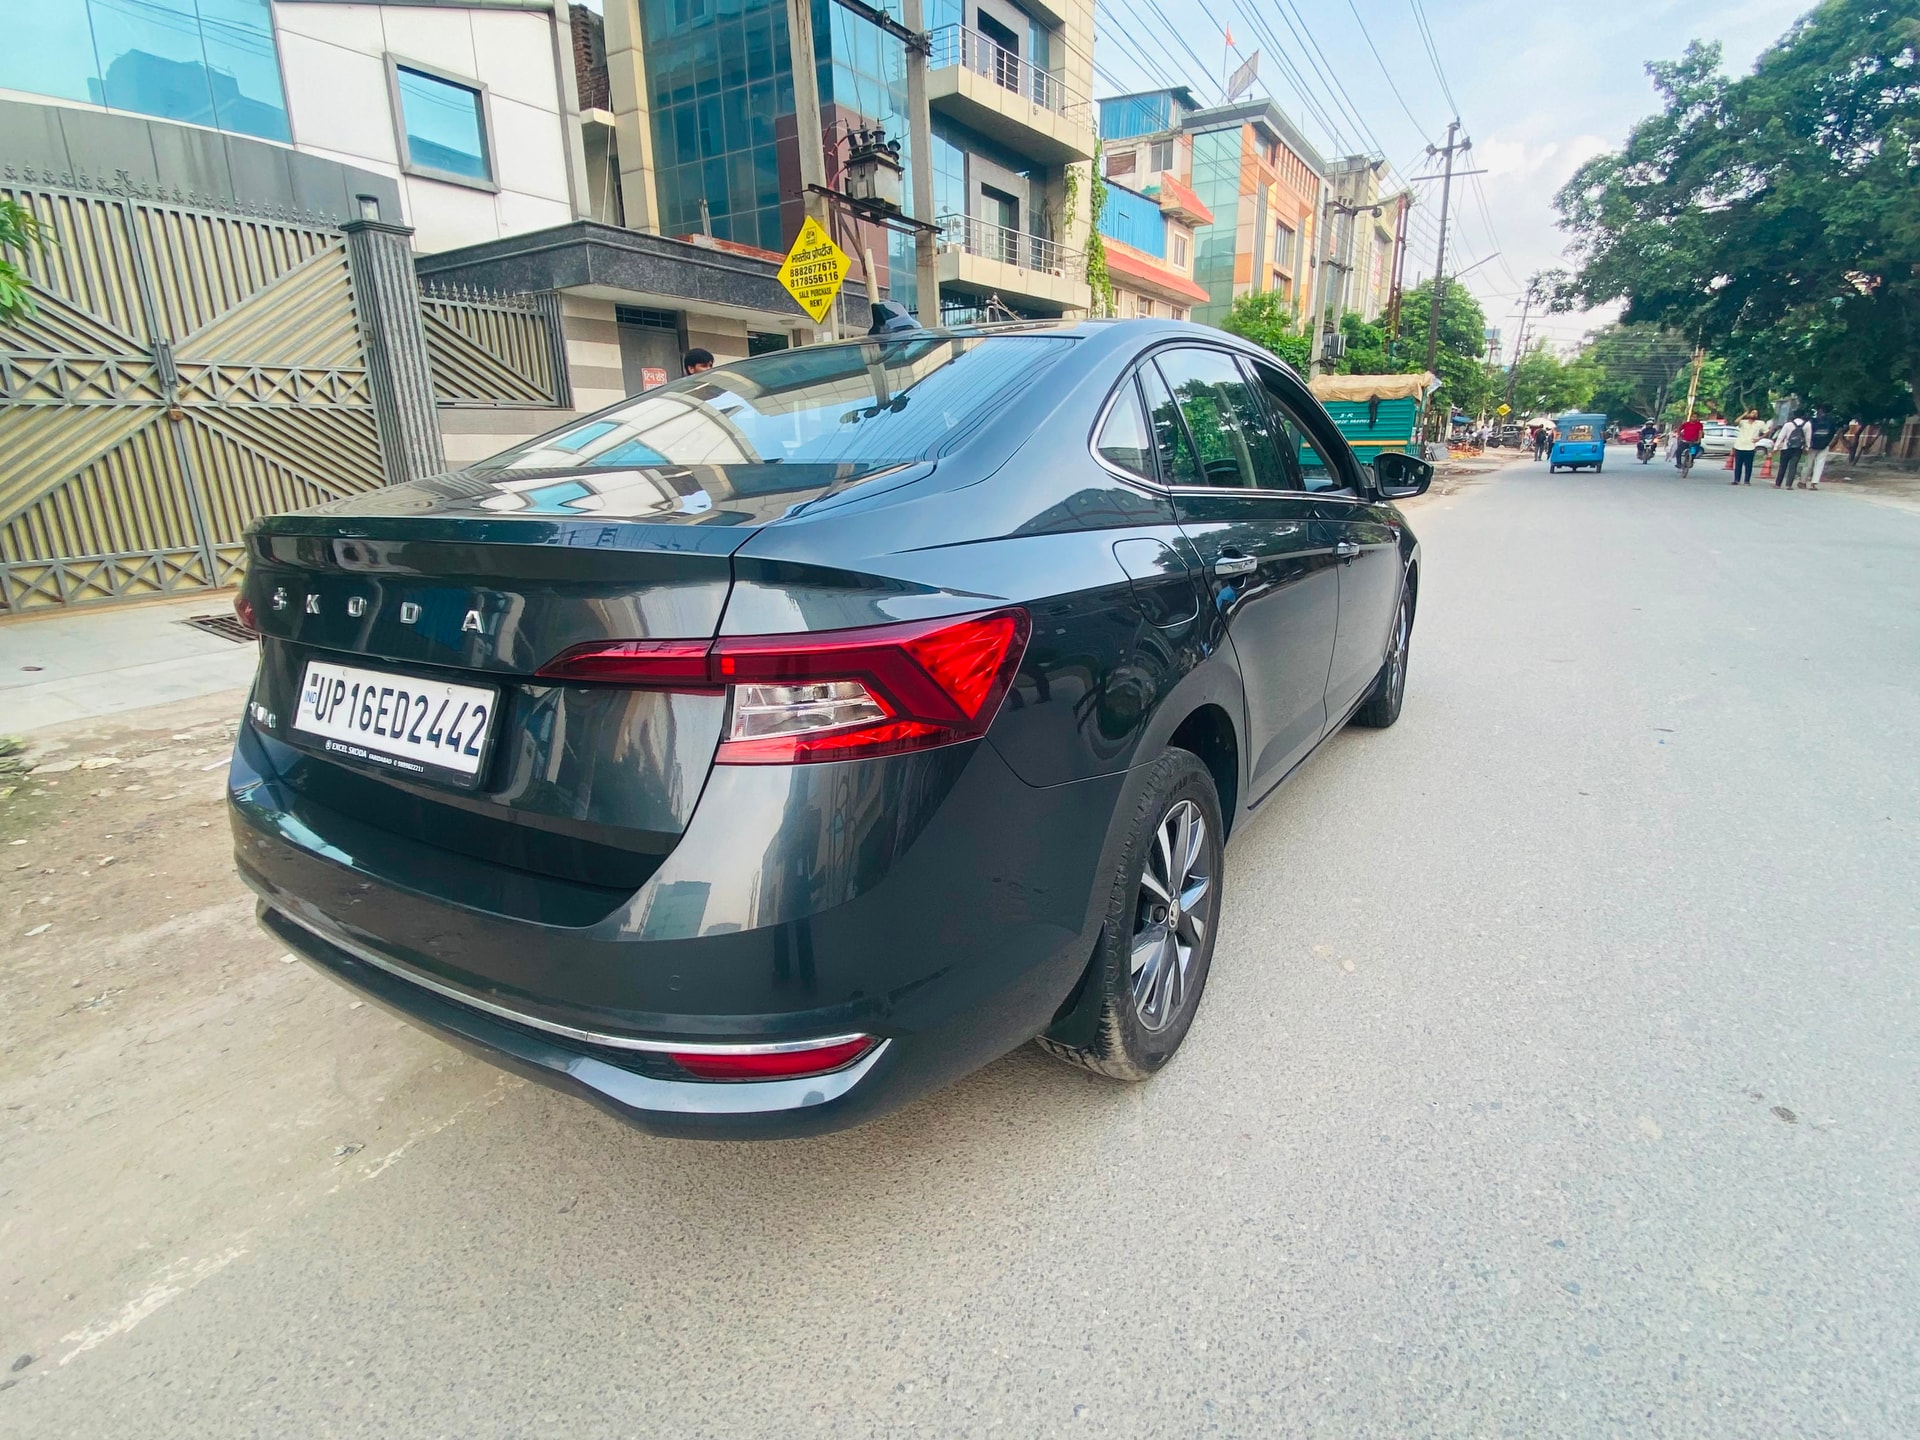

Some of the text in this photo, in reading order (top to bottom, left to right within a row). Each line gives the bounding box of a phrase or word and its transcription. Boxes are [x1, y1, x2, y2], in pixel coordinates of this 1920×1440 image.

[790, 260, 838, 278] 8882677675
[790, 271, 839, 288] 8178556116
[799, 287, 832, 299] SALE PURCHASE
[809, 298, 823, 307] RENT
[304, 690, 317, 704] IND
[314, 676, 487, 757] UP16ED2442
[331, 742, 348, 753] EXCEL
